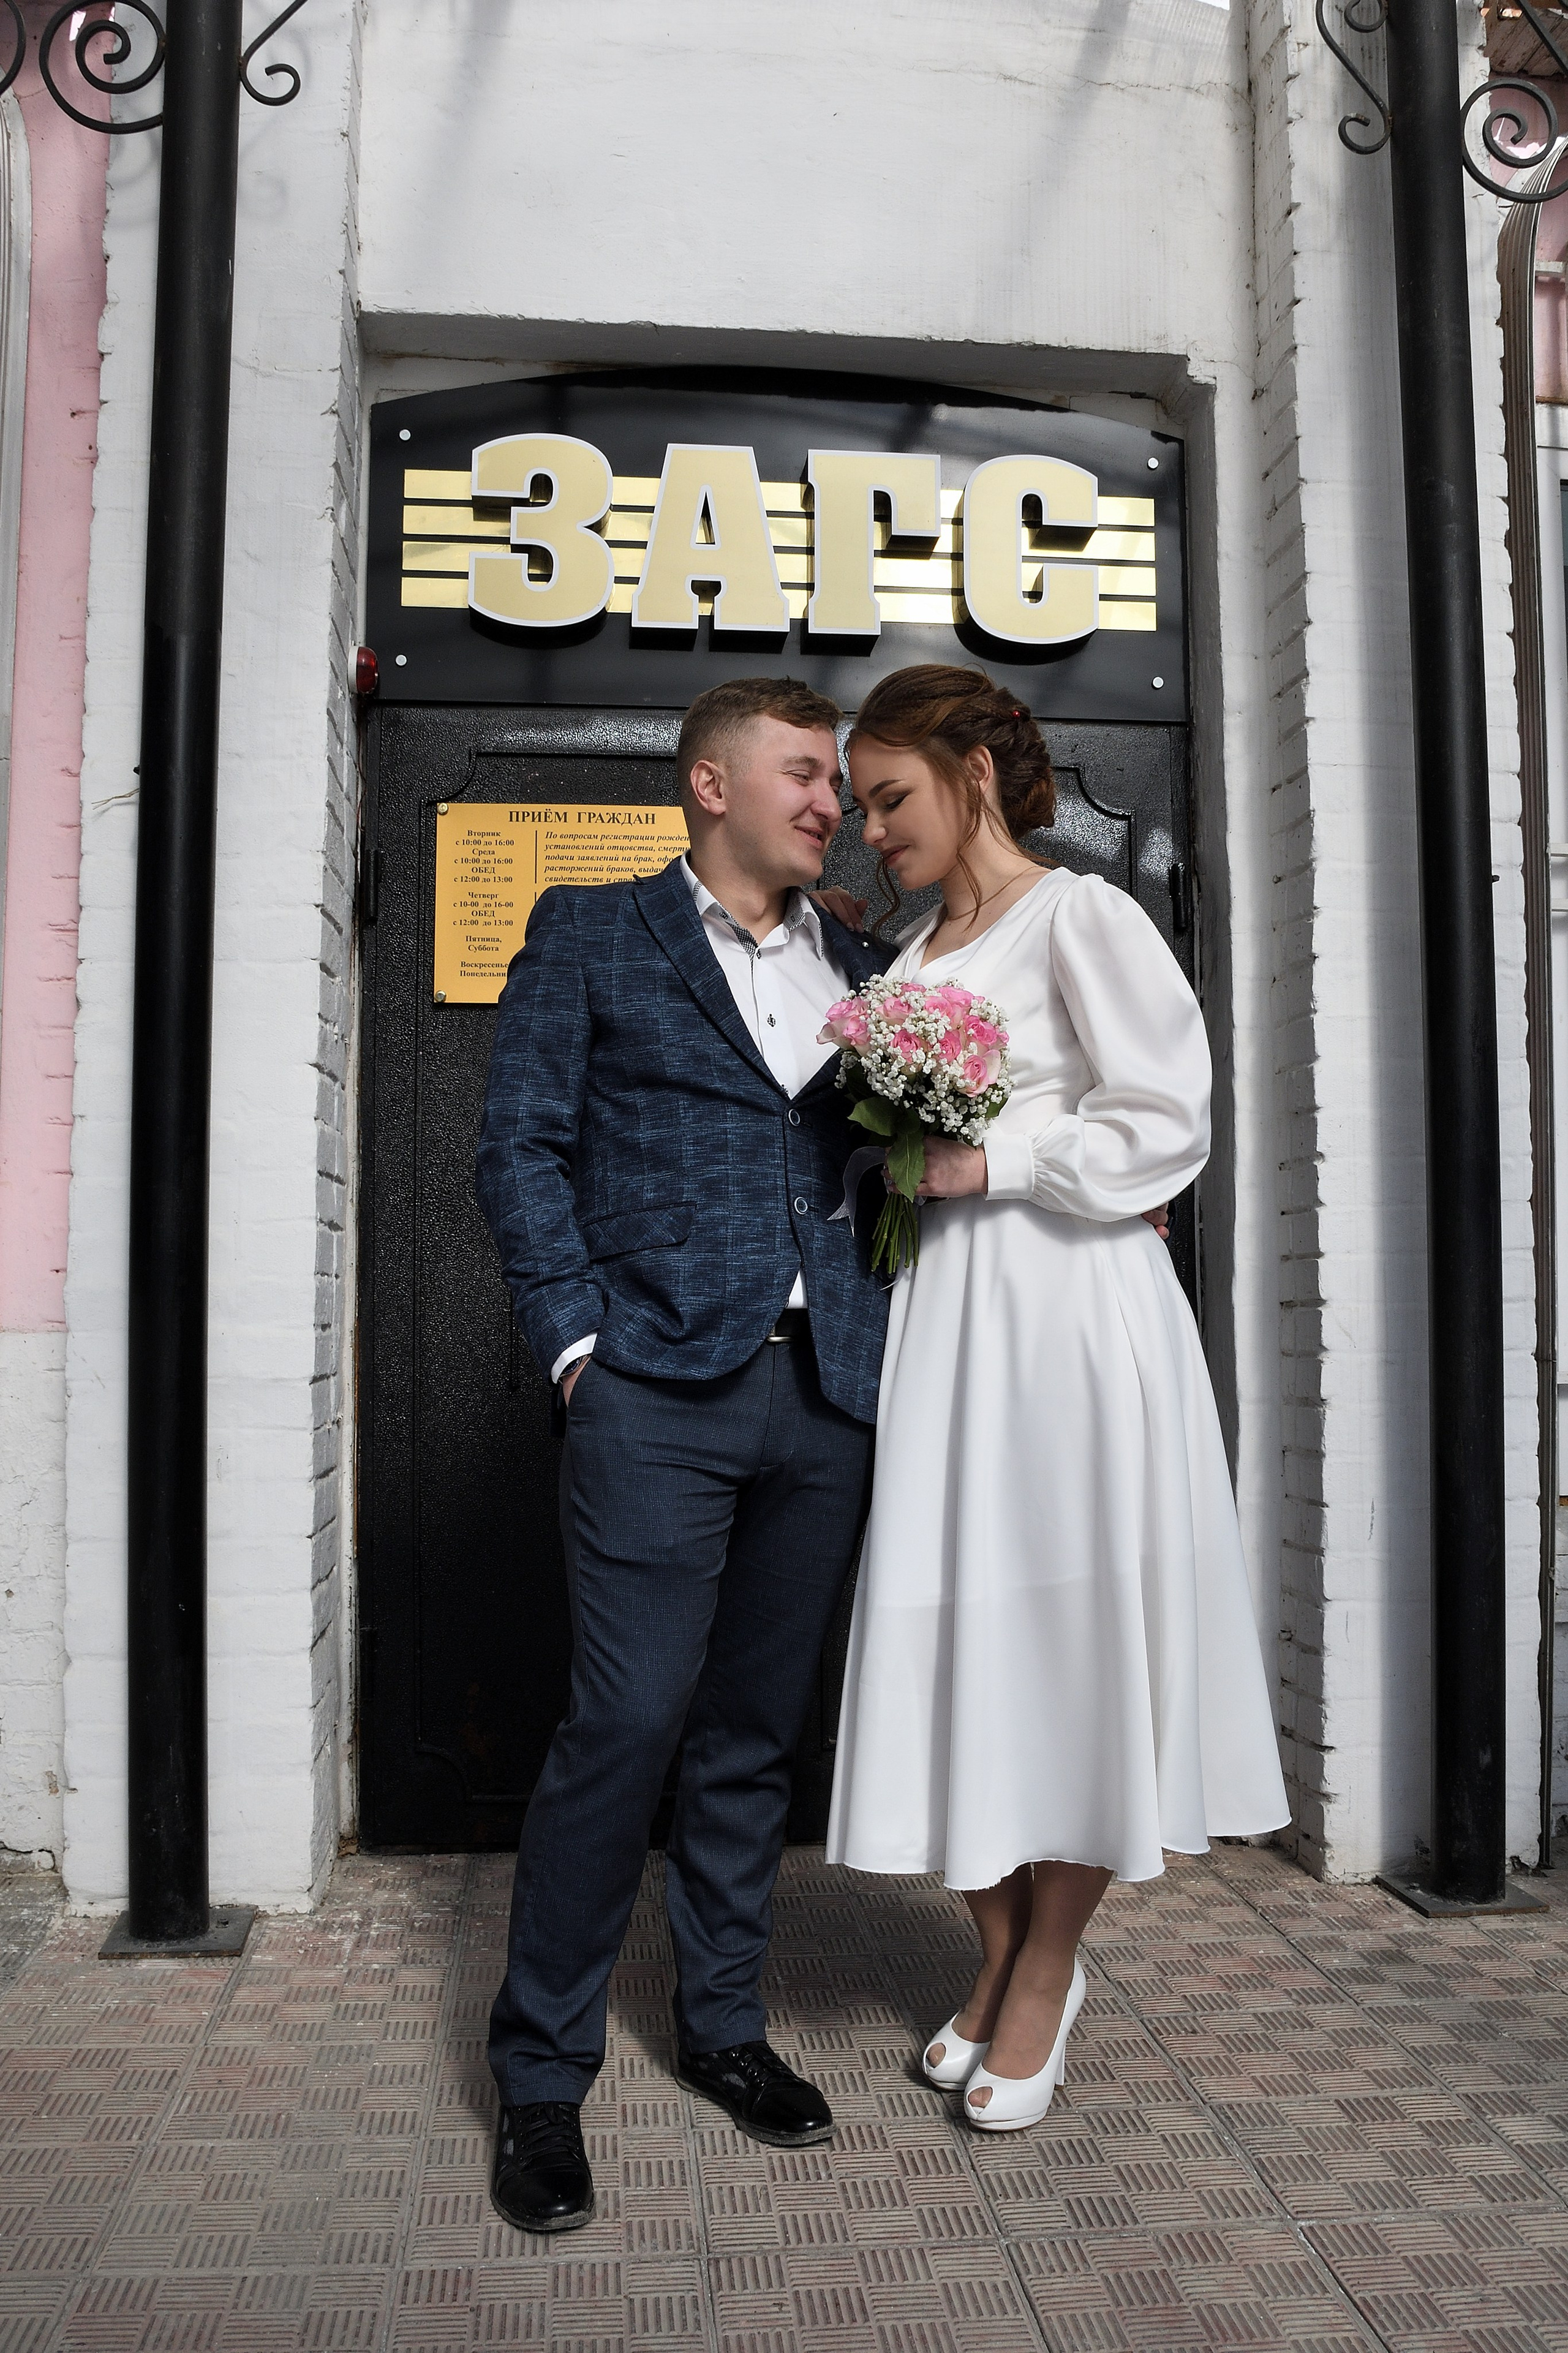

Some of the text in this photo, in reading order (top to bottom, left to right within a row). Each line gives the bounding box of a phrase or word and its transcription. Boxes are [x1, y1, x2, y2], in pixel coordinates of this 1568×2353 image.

[468, 431, 1100, 645] ЗАГС
[508, 808, 656, 826] ПРИЁМ ГРАЖДАН
[656, 834, 690, 842] рожден
[544, 843, 605, 852] установлений
[633, 855, 655, 864] брак,
[657, 855, 674, 864] офо
[544, 864, 604, 873] расторжений
[606, 865, 636, 874] браков,
